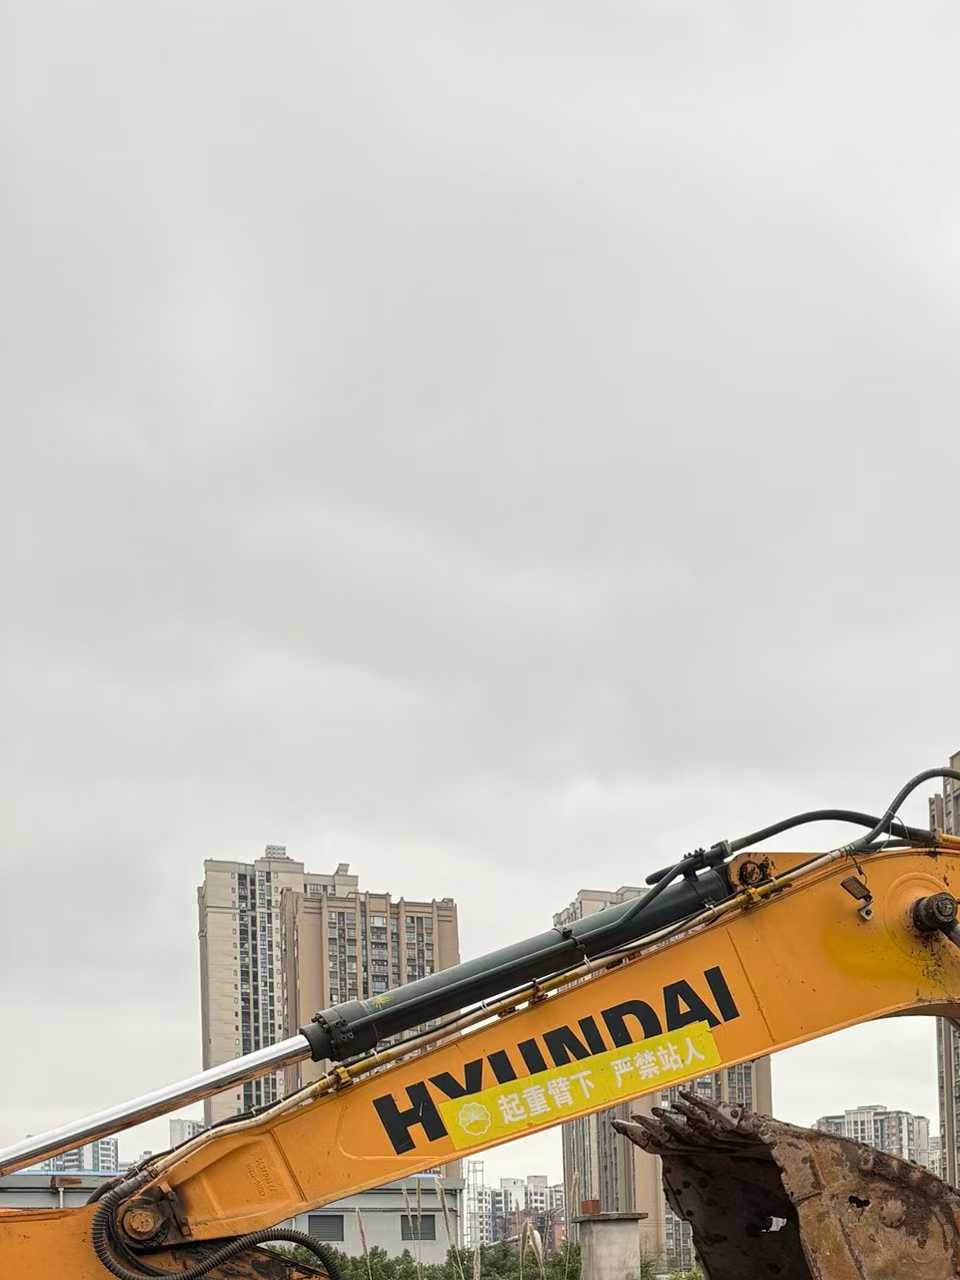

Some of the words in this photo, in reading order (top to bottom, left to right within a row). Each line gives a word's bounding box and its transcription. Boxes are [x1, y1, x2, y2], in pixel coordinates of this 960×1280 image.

[373, 966, 740, 1155] HYUNDAI
[497, 1068, 595, 1124] 起重臂下
[610, 1037, 705, 1089] 严禁站人
